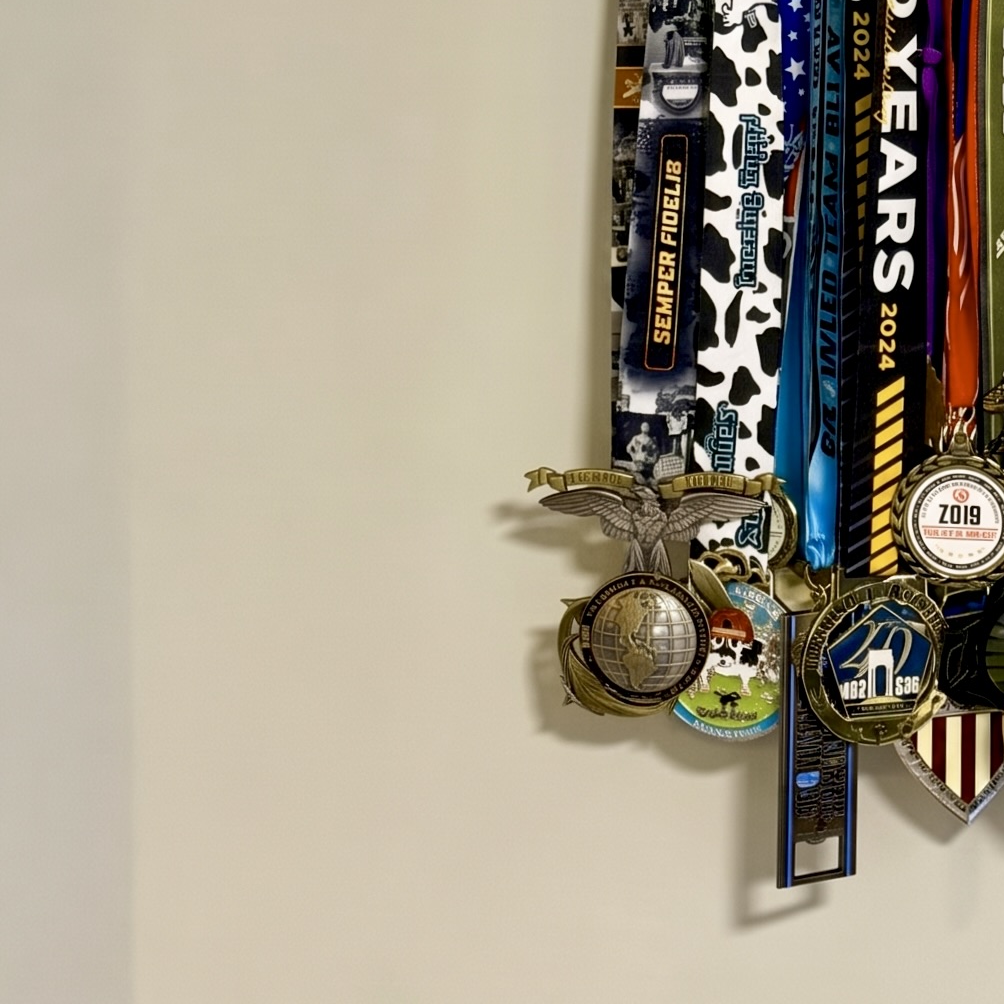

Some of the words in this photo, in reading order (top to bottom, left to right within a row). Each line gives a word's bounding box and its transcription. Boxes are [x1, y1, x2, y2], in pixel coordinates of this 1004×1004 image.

[852, 11, 870, 81] 2024
[872, 34, 918, 294] YEARS
[653, 250, 677, 346] SEMPER
[879, 303, 898, 374] 2024
